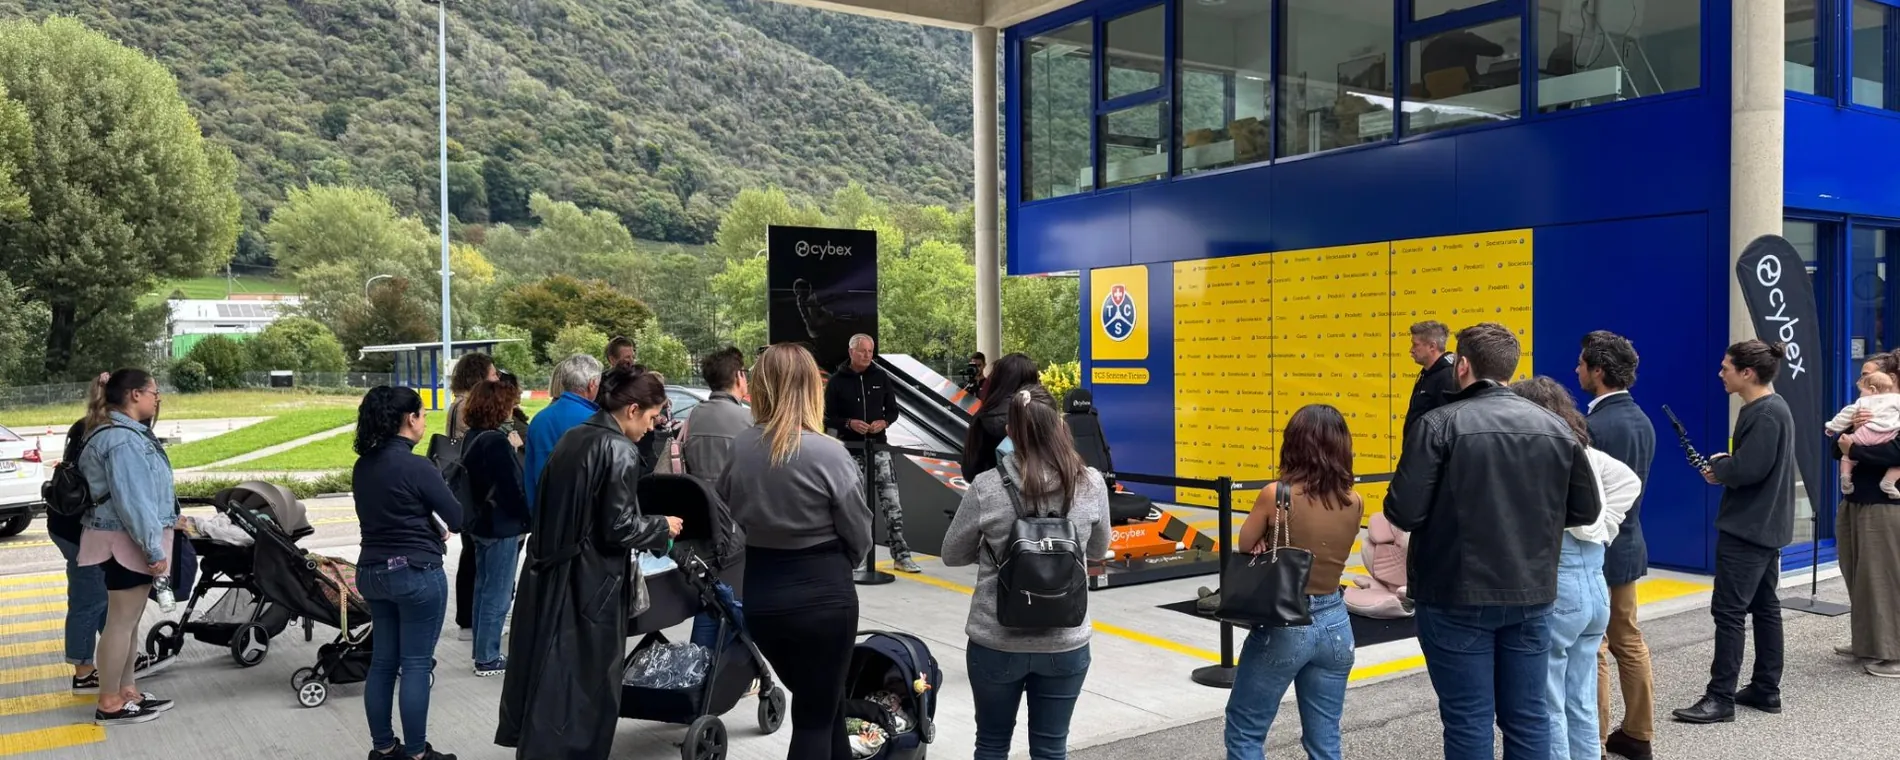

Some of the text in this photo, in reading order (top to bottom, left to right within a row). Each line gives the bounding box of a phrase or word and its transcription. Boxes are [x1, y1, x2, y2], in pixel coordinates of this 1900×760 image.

[810, 240, 852, 260] cybex
[1764, 288, 1806, 380] cybex
[1120, 528, 1146, 542] cybex
